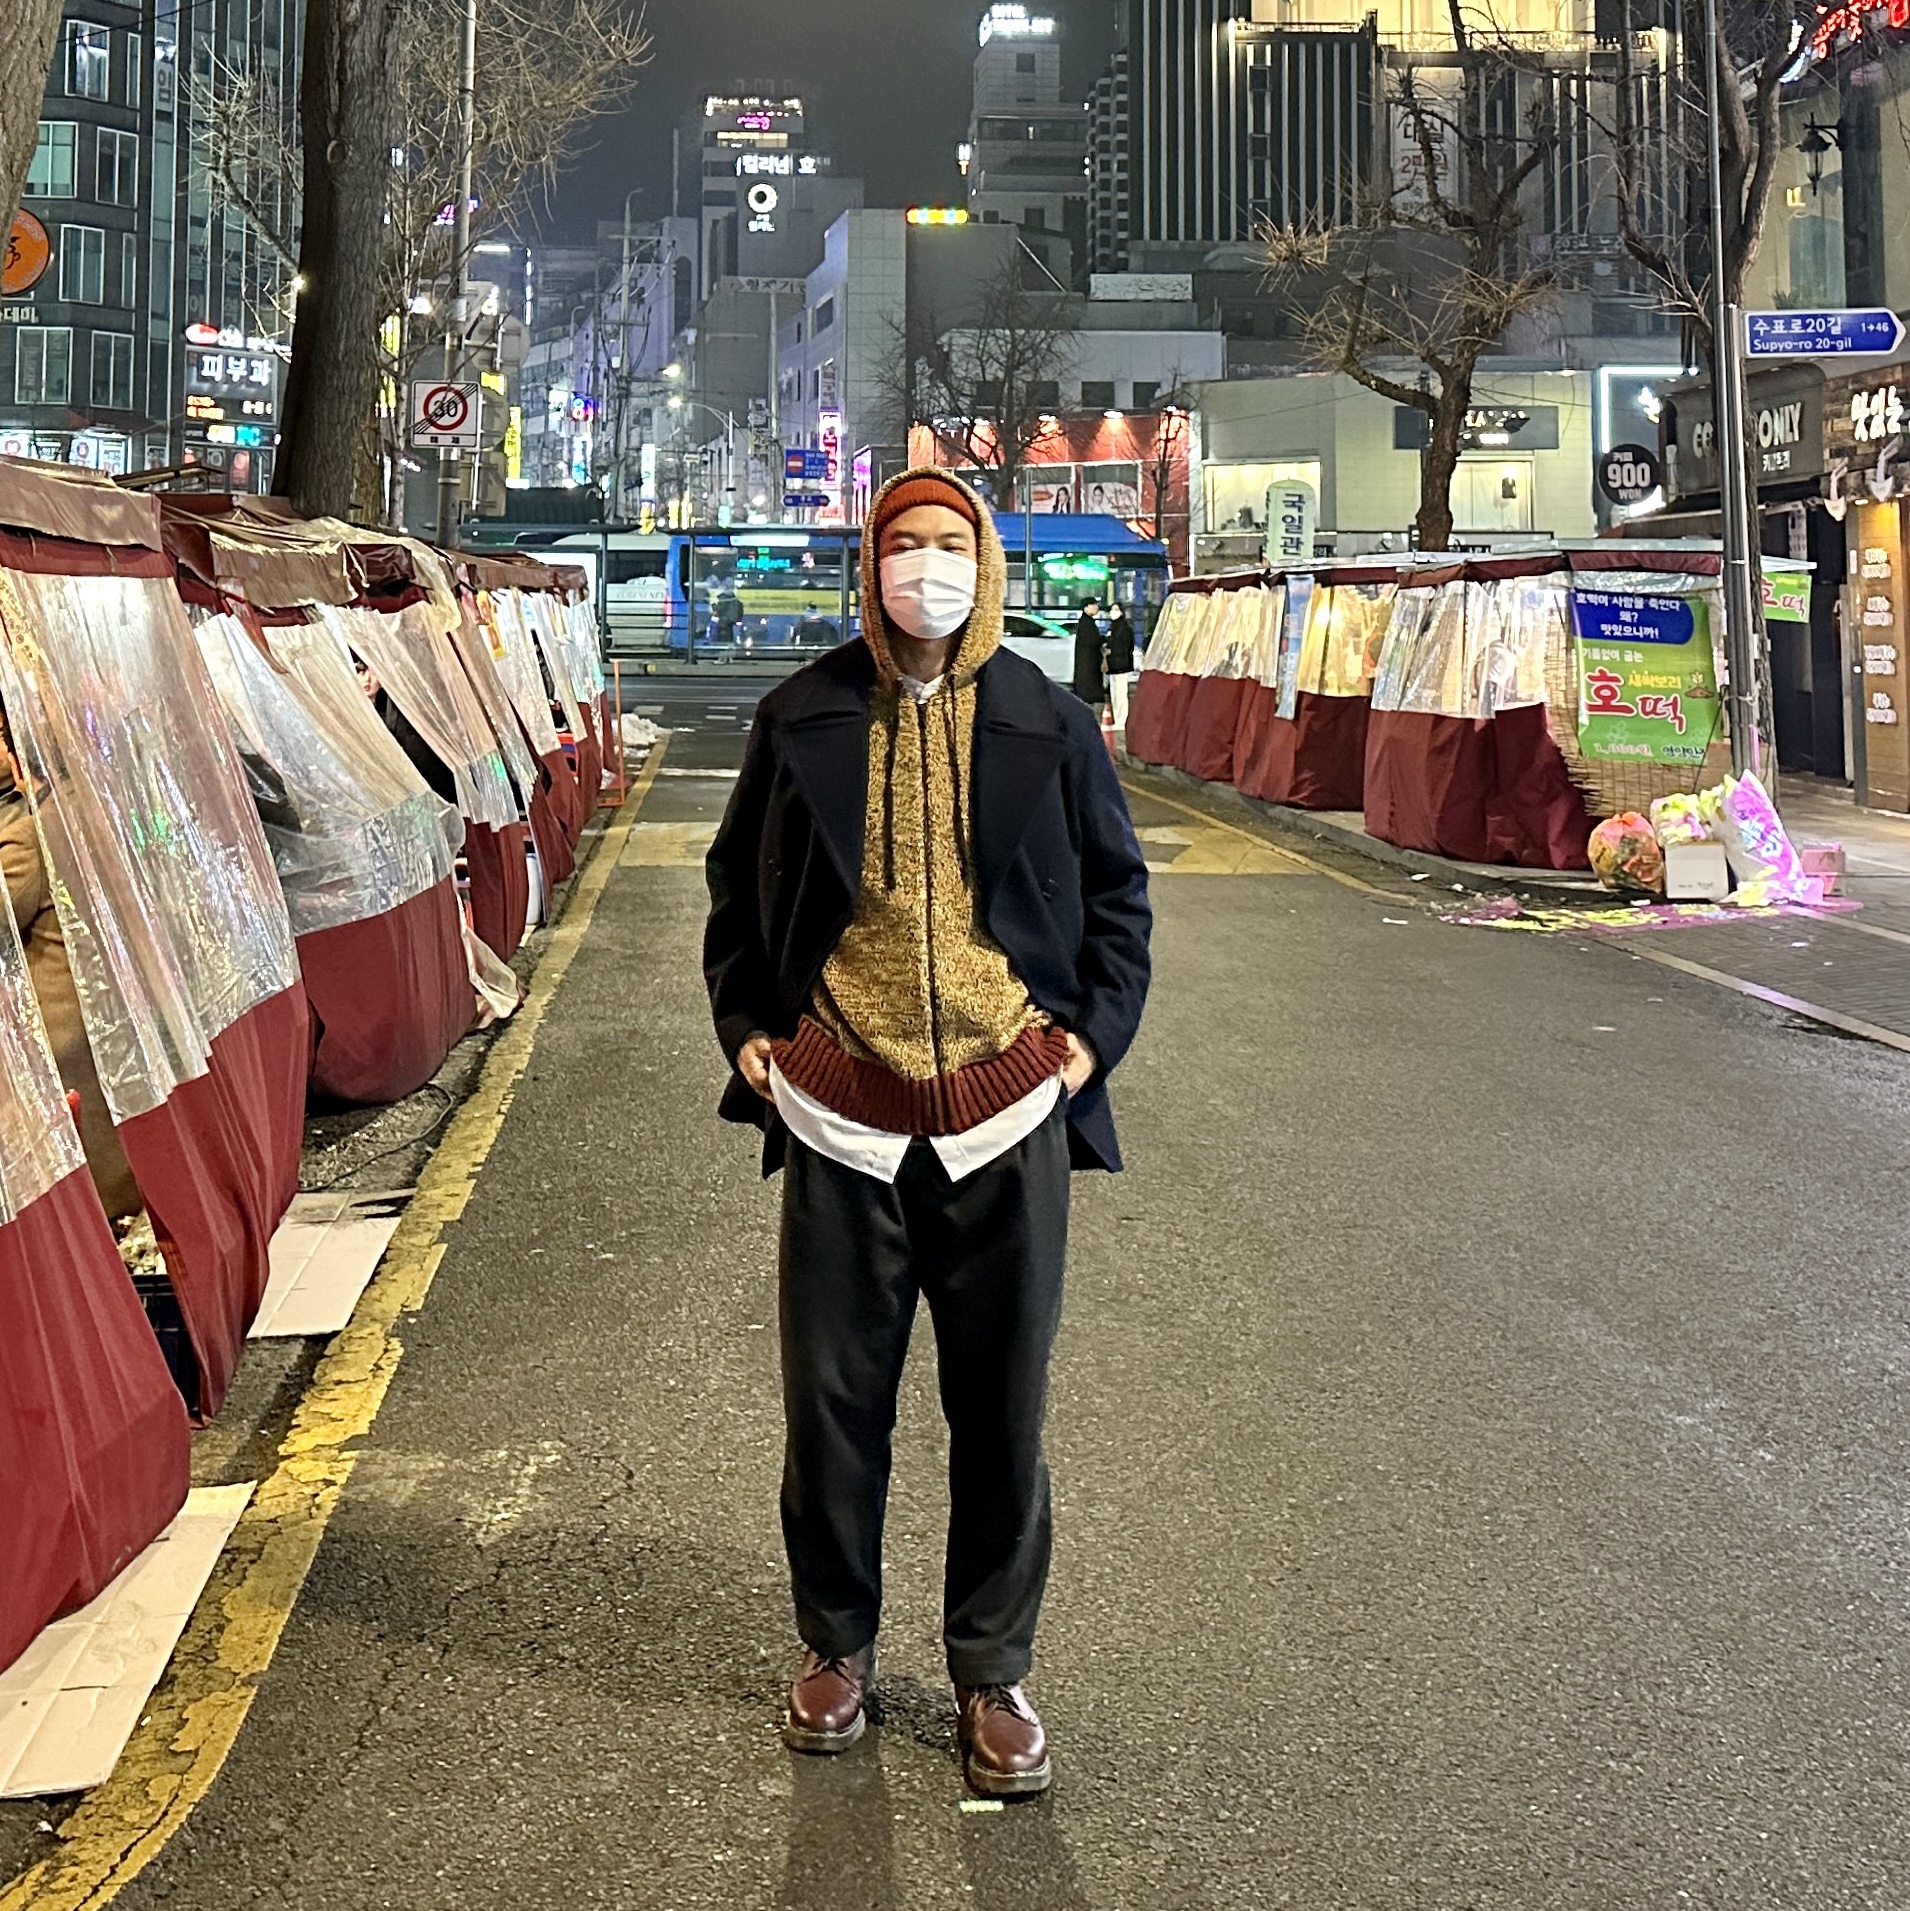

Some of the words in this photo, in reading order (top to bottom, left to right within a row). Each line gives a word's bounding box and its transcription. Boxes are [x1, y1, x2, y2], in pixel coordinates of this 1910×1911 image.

[1752, 316, 1842, 337] 수표로20길
[1753, 338, 1813, 352] Supyo-ro
[1815, 337, 1852, 351] 20-gil
[201, 354, 272, 386] 피부과
[434, 400, 458, 417] 30
[1758, 402, 1803, 448] ONLY
[1612, 452, 1634, 462] 커피
[1607, 463, 1651, 488] 900
[1618, 489, 1643, 500] WON
[1281, 492, 1306, 556] 국일관
[1619, 611, 1639, 623] 왜?
[1600, 624, 1660, 639] 맛있으니까!
[1628, 669, 1682, 690] 새싹보리
[1584, 666, 1687, 735] 호떡
